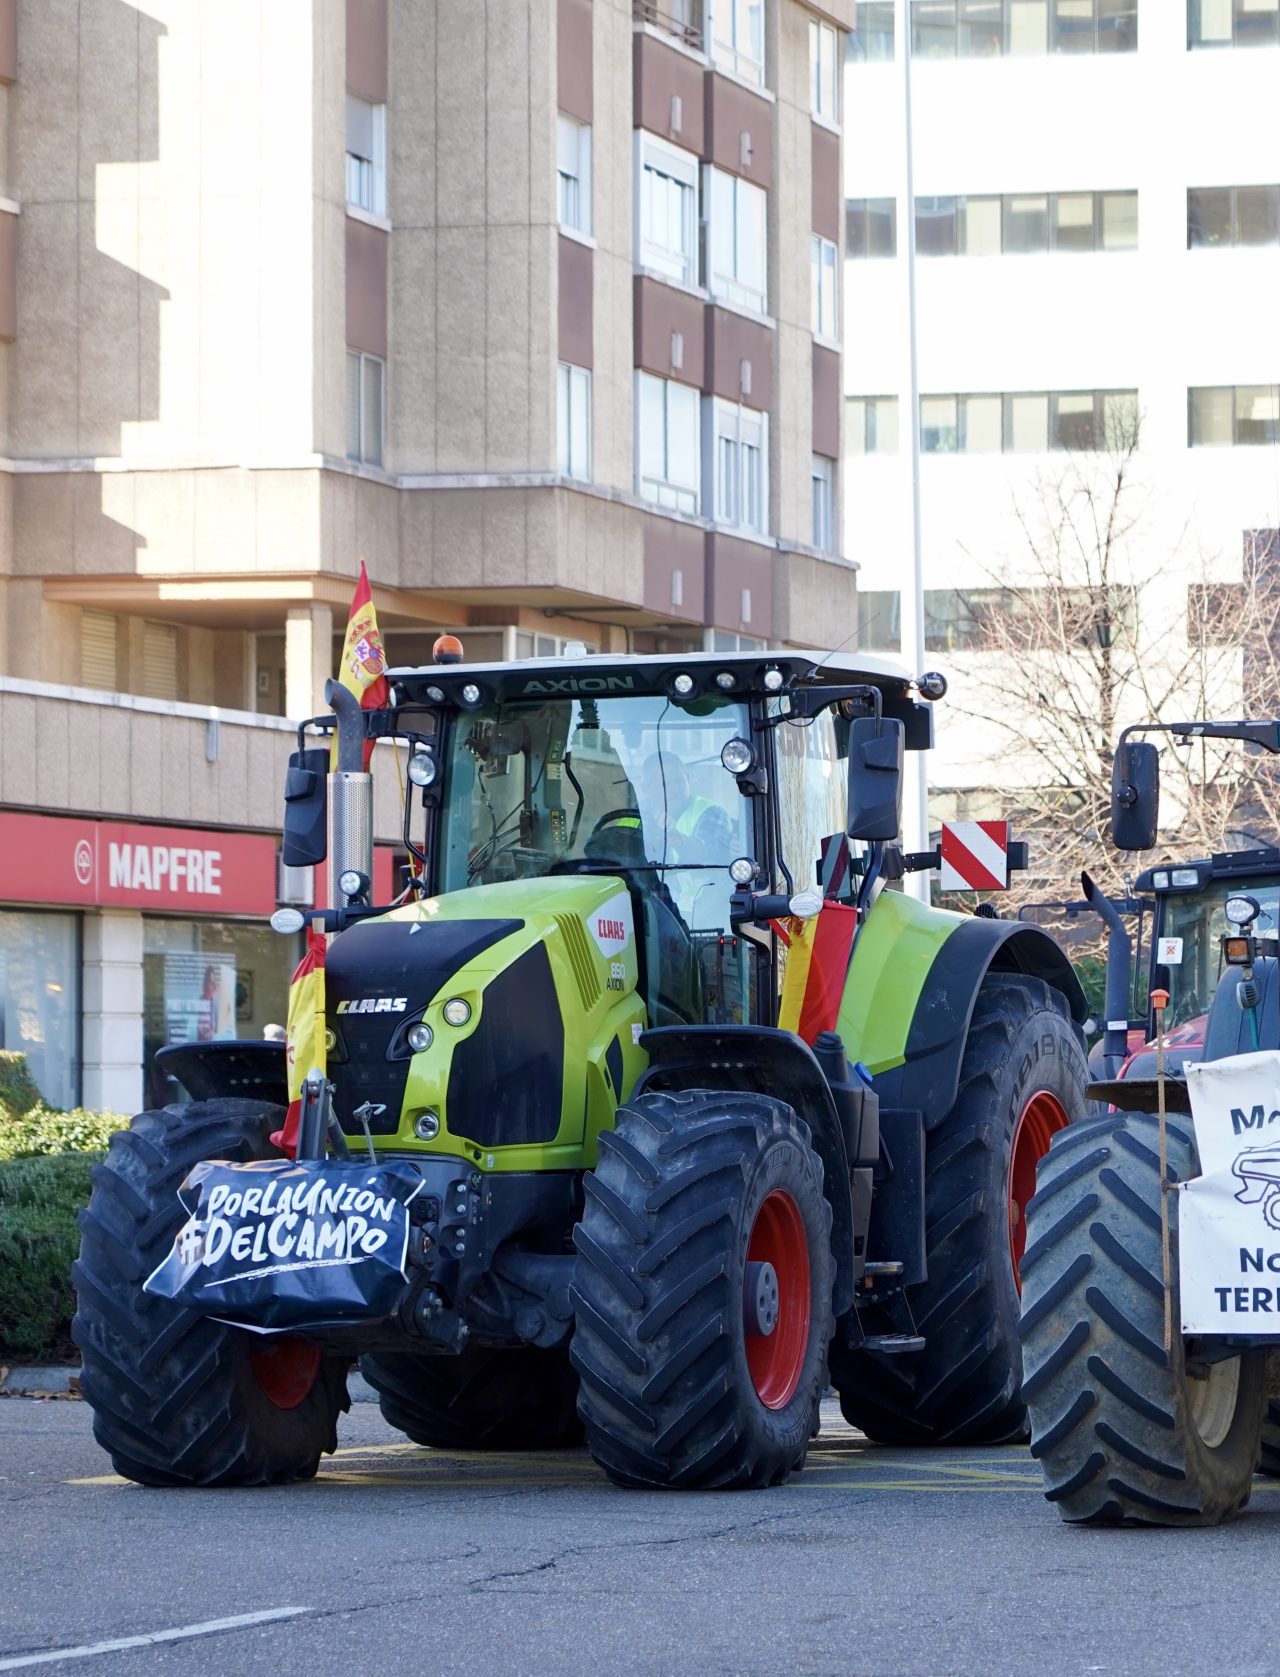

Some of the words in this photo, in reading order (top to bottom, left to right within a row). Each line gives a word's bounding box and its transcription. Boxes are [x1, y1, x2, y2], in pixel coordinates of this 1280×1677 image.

[522, 674, 634, 693] AXION
[109, 842, 221, 895] MAPFRE
[597, 919, 625, 940] CLAAS
[606, 977, 625, 991] AXION
[336, 997, 408, 1015] CLAAS
